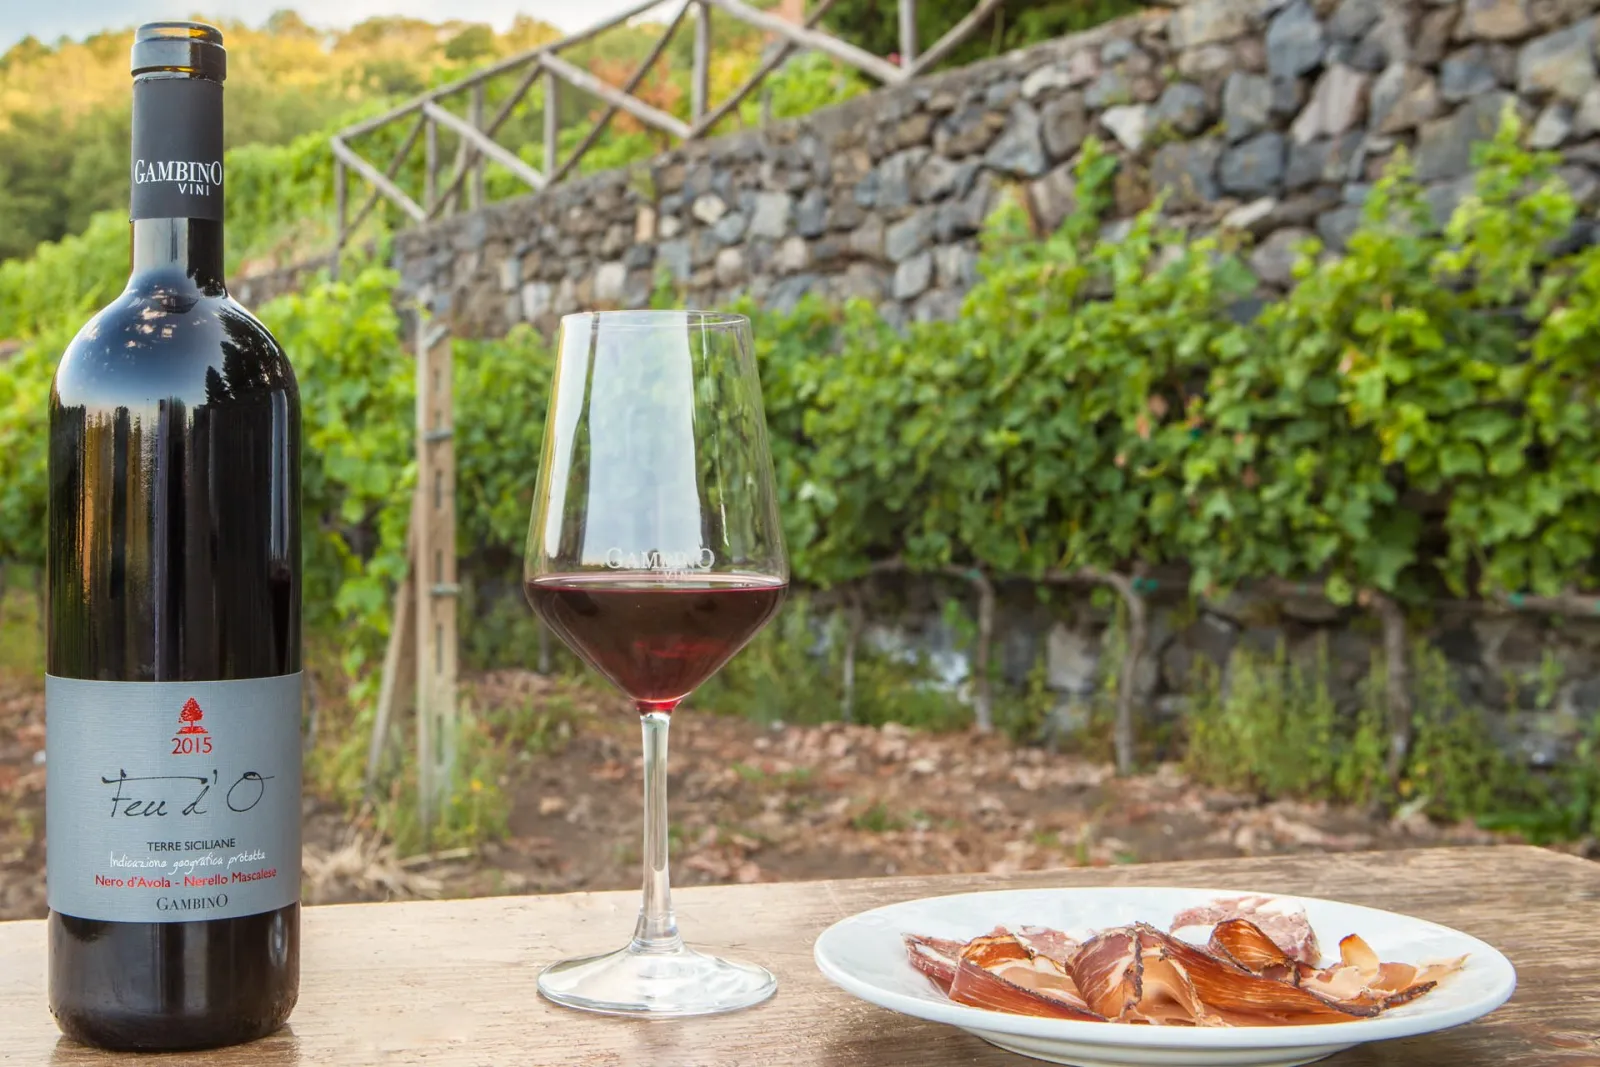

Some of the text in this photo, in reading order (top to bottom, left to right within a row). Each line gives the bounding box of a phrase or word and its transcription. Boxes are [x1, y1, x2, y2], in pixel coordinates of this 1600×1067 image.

[134, 159, 223, 186] GAMBINO
[178, 183, 210, 196] VINI
[171, 736, 213, 755] 2015
[101, 768, 208, 817] Feu
[147, 837, 236, 852] TERRE SICILIANE
[109, 849, 266, 875] Indicazione geografica protetta
[95, 874, 124, 888] Nero
[127, 876, 171, 889] d'Avola
[184, 875, 228, 887] Nerello
[231, 867, 277, 884] Mascalese
[156, 893, 229, 911] GAMBINO
